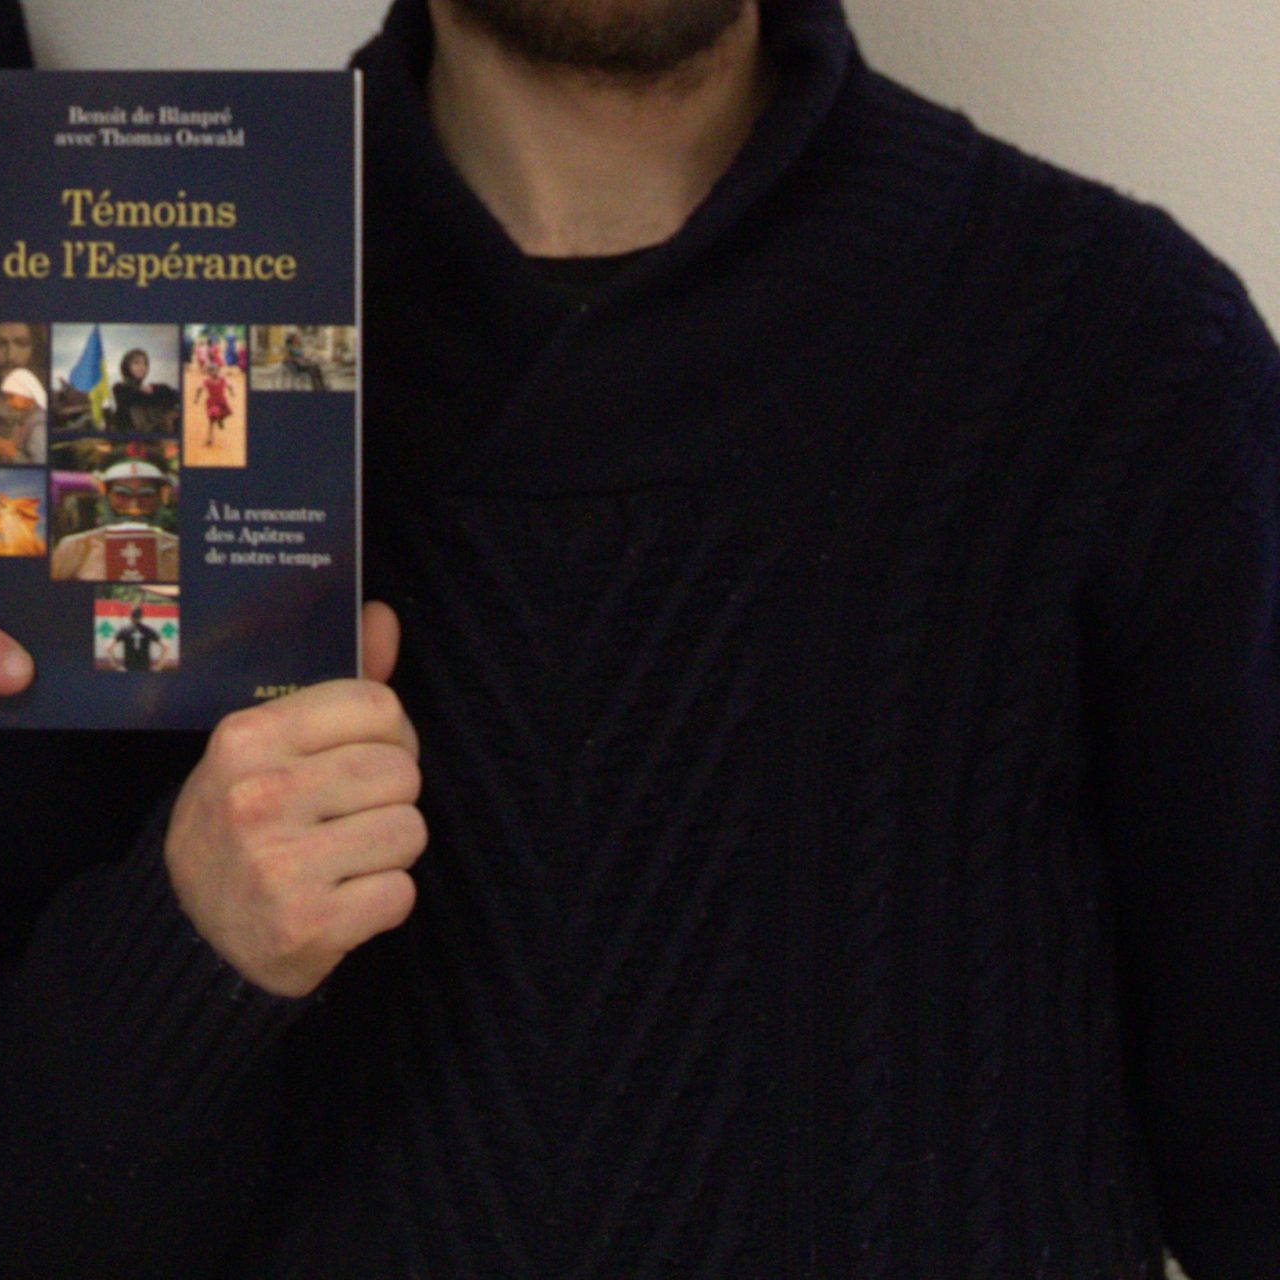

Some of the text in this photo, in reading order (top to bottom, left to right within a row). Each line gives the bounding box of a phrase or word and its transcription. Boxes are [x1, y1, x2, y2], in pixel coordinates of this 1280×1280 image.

[131, 106, 154, 125] de
[54, 127, 245, 147] avec Thomas Oswald
[61, 188, 238, 228] Témoins
[2, 240, 51, 278] de
[204, 499, 327, 522] À la rencontre
[204, 525, 305, 546] des Apôtres
[204, 547, 332, 569] de notre temps
